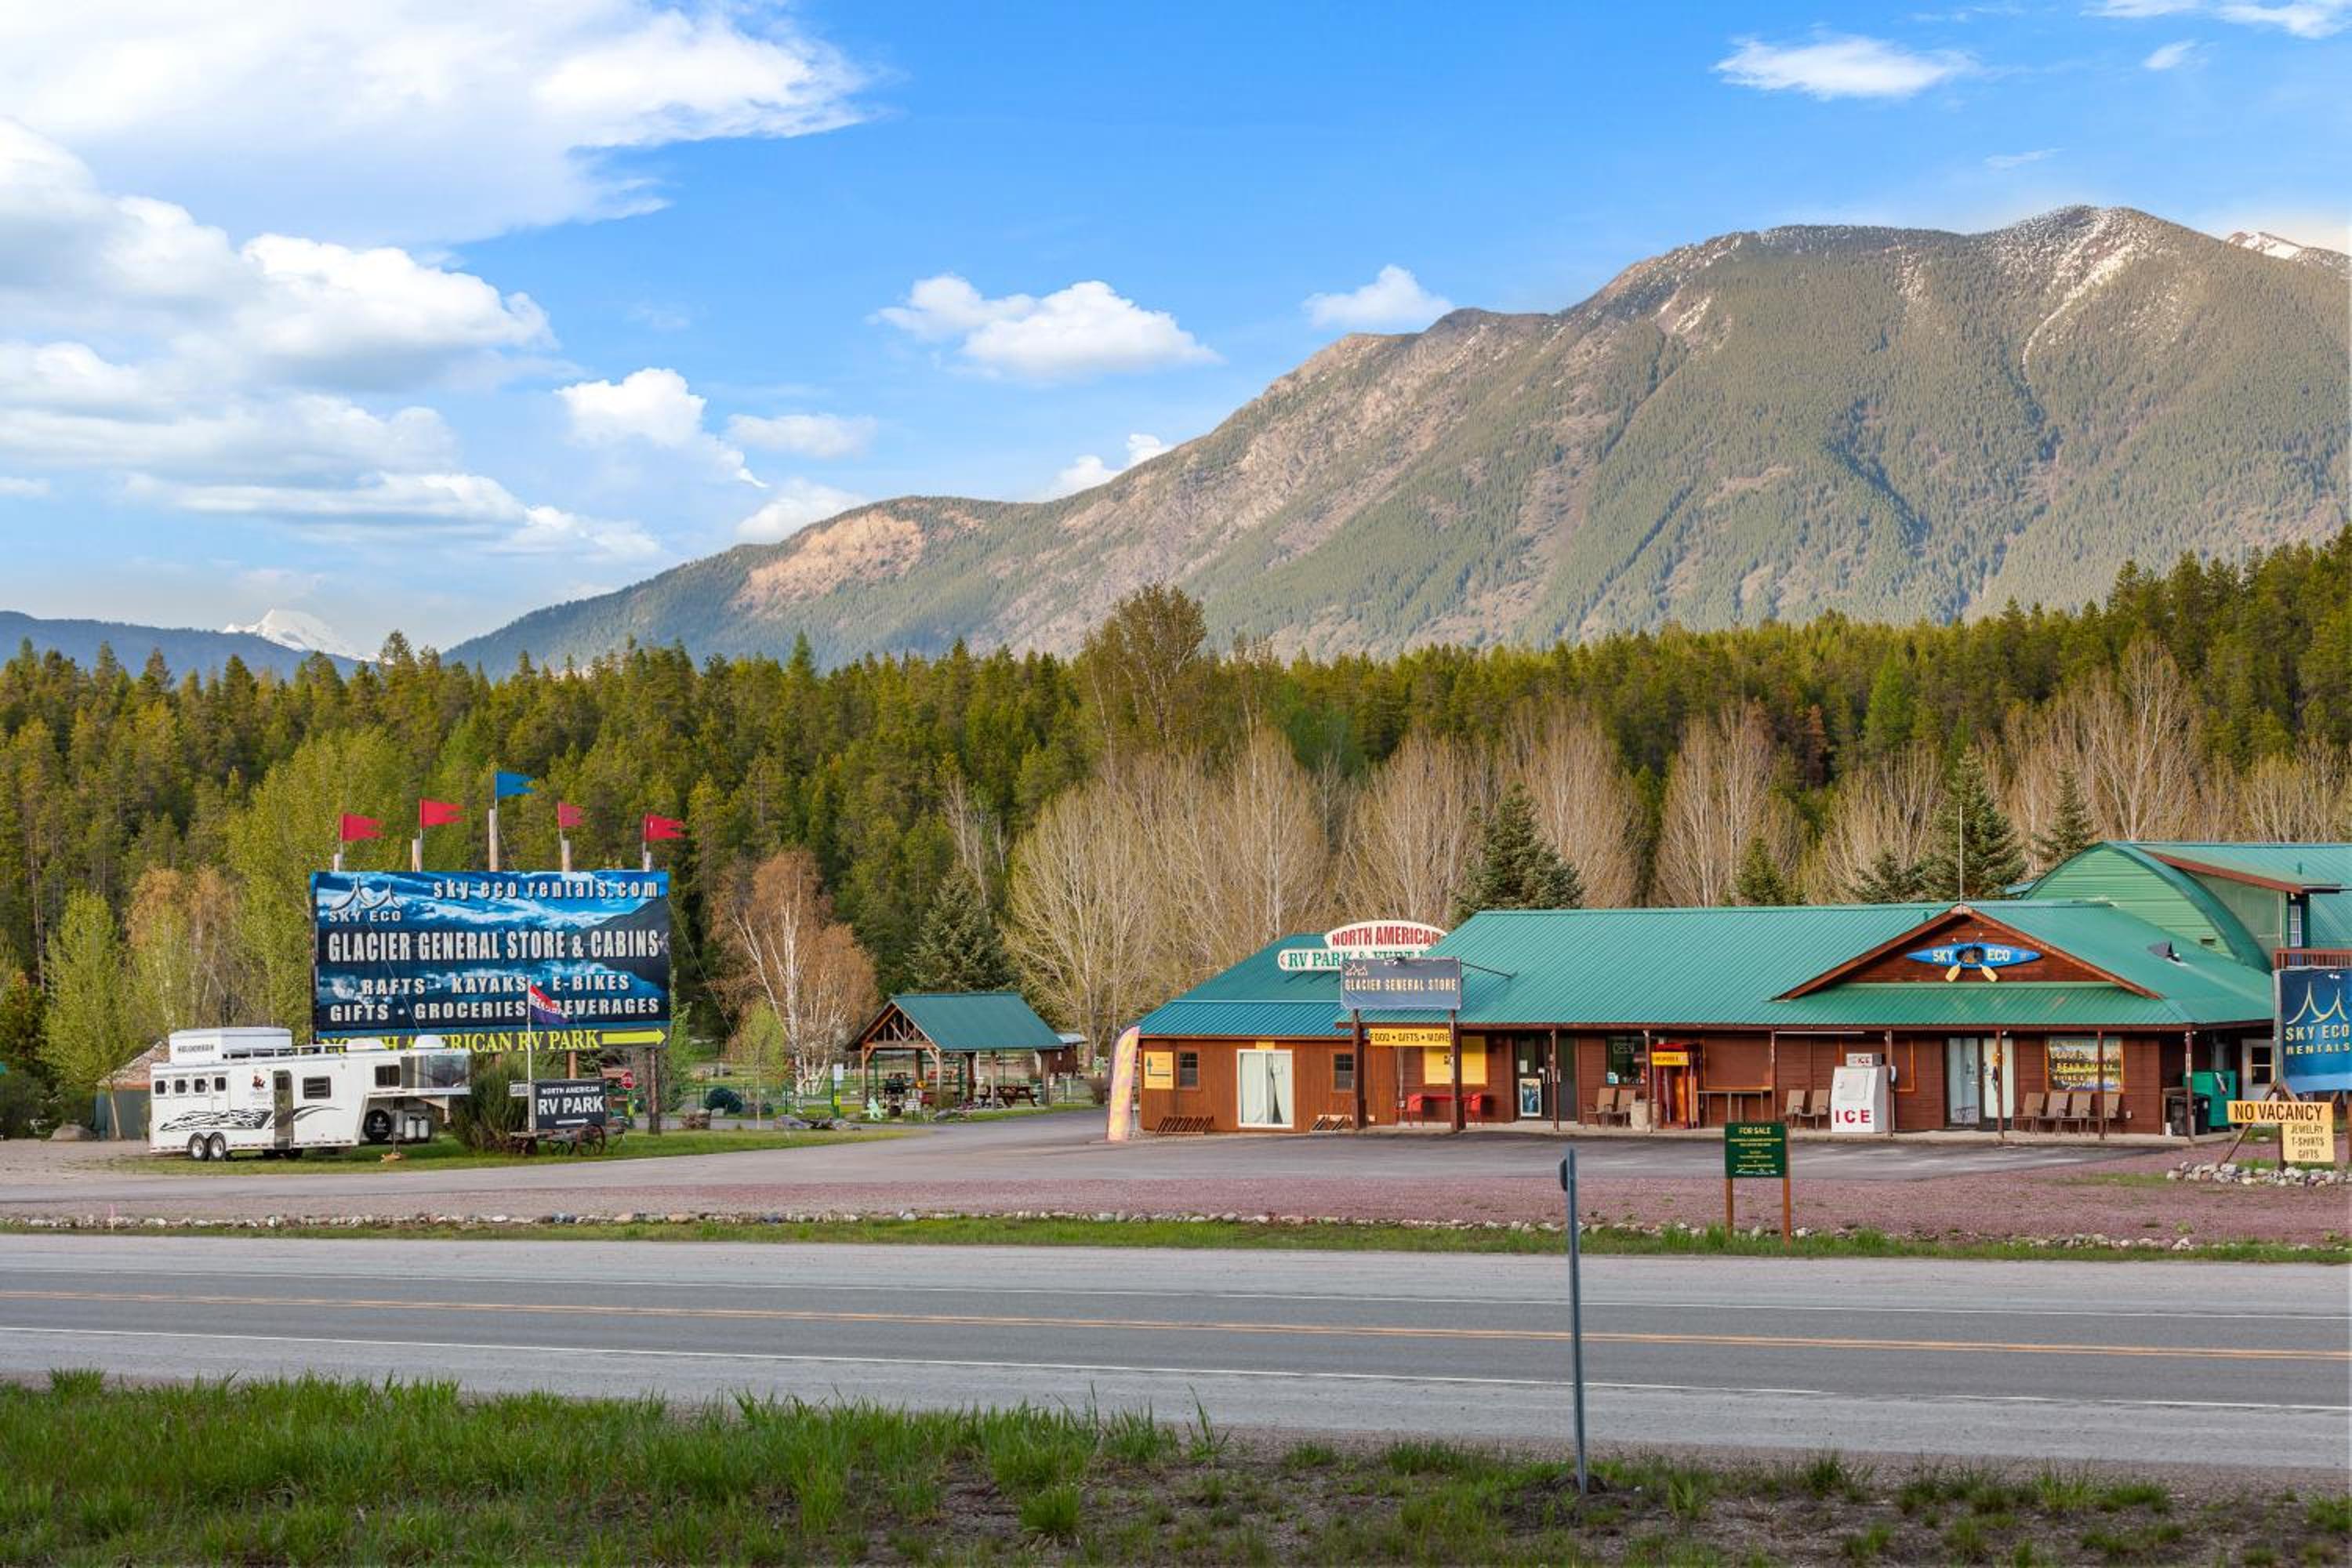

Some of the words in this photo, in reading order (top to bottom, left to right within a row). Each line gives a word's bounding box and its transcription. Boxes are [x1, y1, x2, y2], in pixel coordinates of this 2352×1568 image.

[433, 879, 469, 899] sky
[480, 881, 517, 898] eco
[528, 880, 658, 898] rentals.com
[328, 909, 361, 923] SKY
[369, 910, 402, 922] ECO
[1333, 927, 1372, 946] NORTH
[328, 932, 412, 962] GLACIER
[418, 931, 501, 960] GENERAL
[506, 930, 566, 959] STORE
[572, 935, 584, 958] &
[590, 929, 659, 958] CABINS
[1288, 953, 1308, 967] RV
[1312, 950, 1352, 967] PARK
[1932, 949, 1954, 962] SKY
[1987, 948, 2010, 962] ECO
[361, 978, 426, 995] RAFTS
[451, 976, 527, 993] KAYAKS
[553, 975, 630, 990] E-BIKES
[1428, 978, 1456, 992] STORE
[330, 1004, 389, 1022] GIFTS
[415, 1001, 526, 1019] GROCERIES
[2285, 1026, 2314, 1042] SKY
[2321, 1024, 2350, 1039] ECO
[405, 1033, 514, 1054] ARICAN
[517, 1032, 545, 1051] RV
[548, 1029, 601, 1050] PARK
[2285, 1042, 2351, 1055] RENTALS
[565, 1085, 600, 1094] AMERICAN
[537, 1098, 559, 1116] RV
[562, 1096, 604, 1114] PARK
[2234, 1104, 2255, 1120] NO
[2257, 1104, 2324, 1120] VACANCY
[1835, 1109, 1871, 1123] ICE
[2291, 1137, 2325, 1147] T-SHIRTS
[2298, 1149, 2320, 1160] GIFTS
